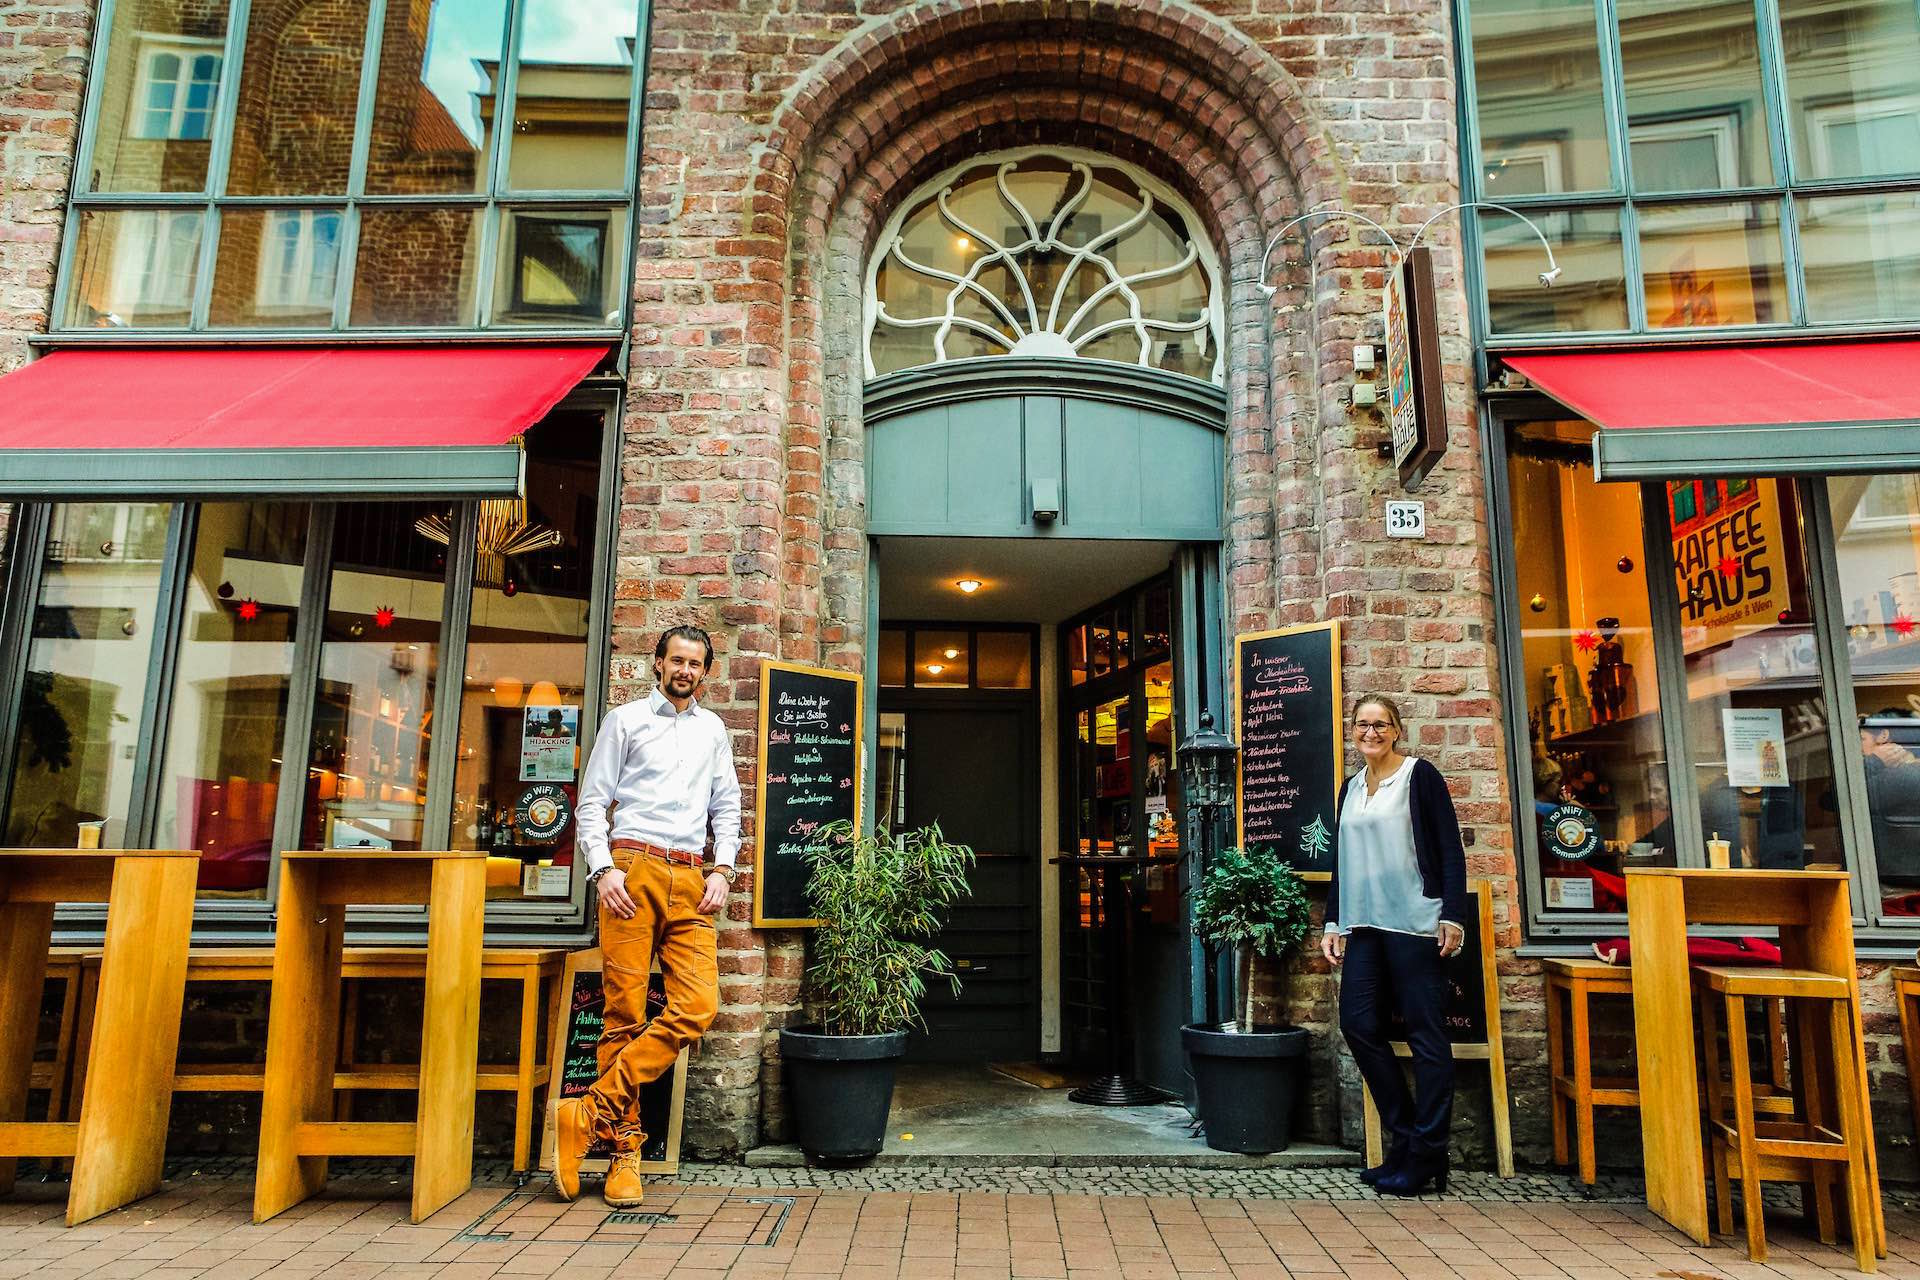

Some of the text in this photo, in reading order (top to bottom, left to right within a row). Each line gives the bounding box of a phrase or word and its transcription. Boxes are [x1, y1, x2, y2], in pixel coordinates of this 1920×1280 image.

[1392, 508, 1420, 528] 35
[1674, 502, 1765, 580] KAFFEE
[1680, 545, 1771, 621] HAUS
[1702, 599, 1773, 629] Schokolade & Wein
[806, 710, 827, 720] Bistro
[522, 786, 554, 804] no WiFi
[525, 812, 569, 838] communicate!
[1549, 806, 1582, 822] no WiFi
[1551, 835, 1598, 859] communicate!
